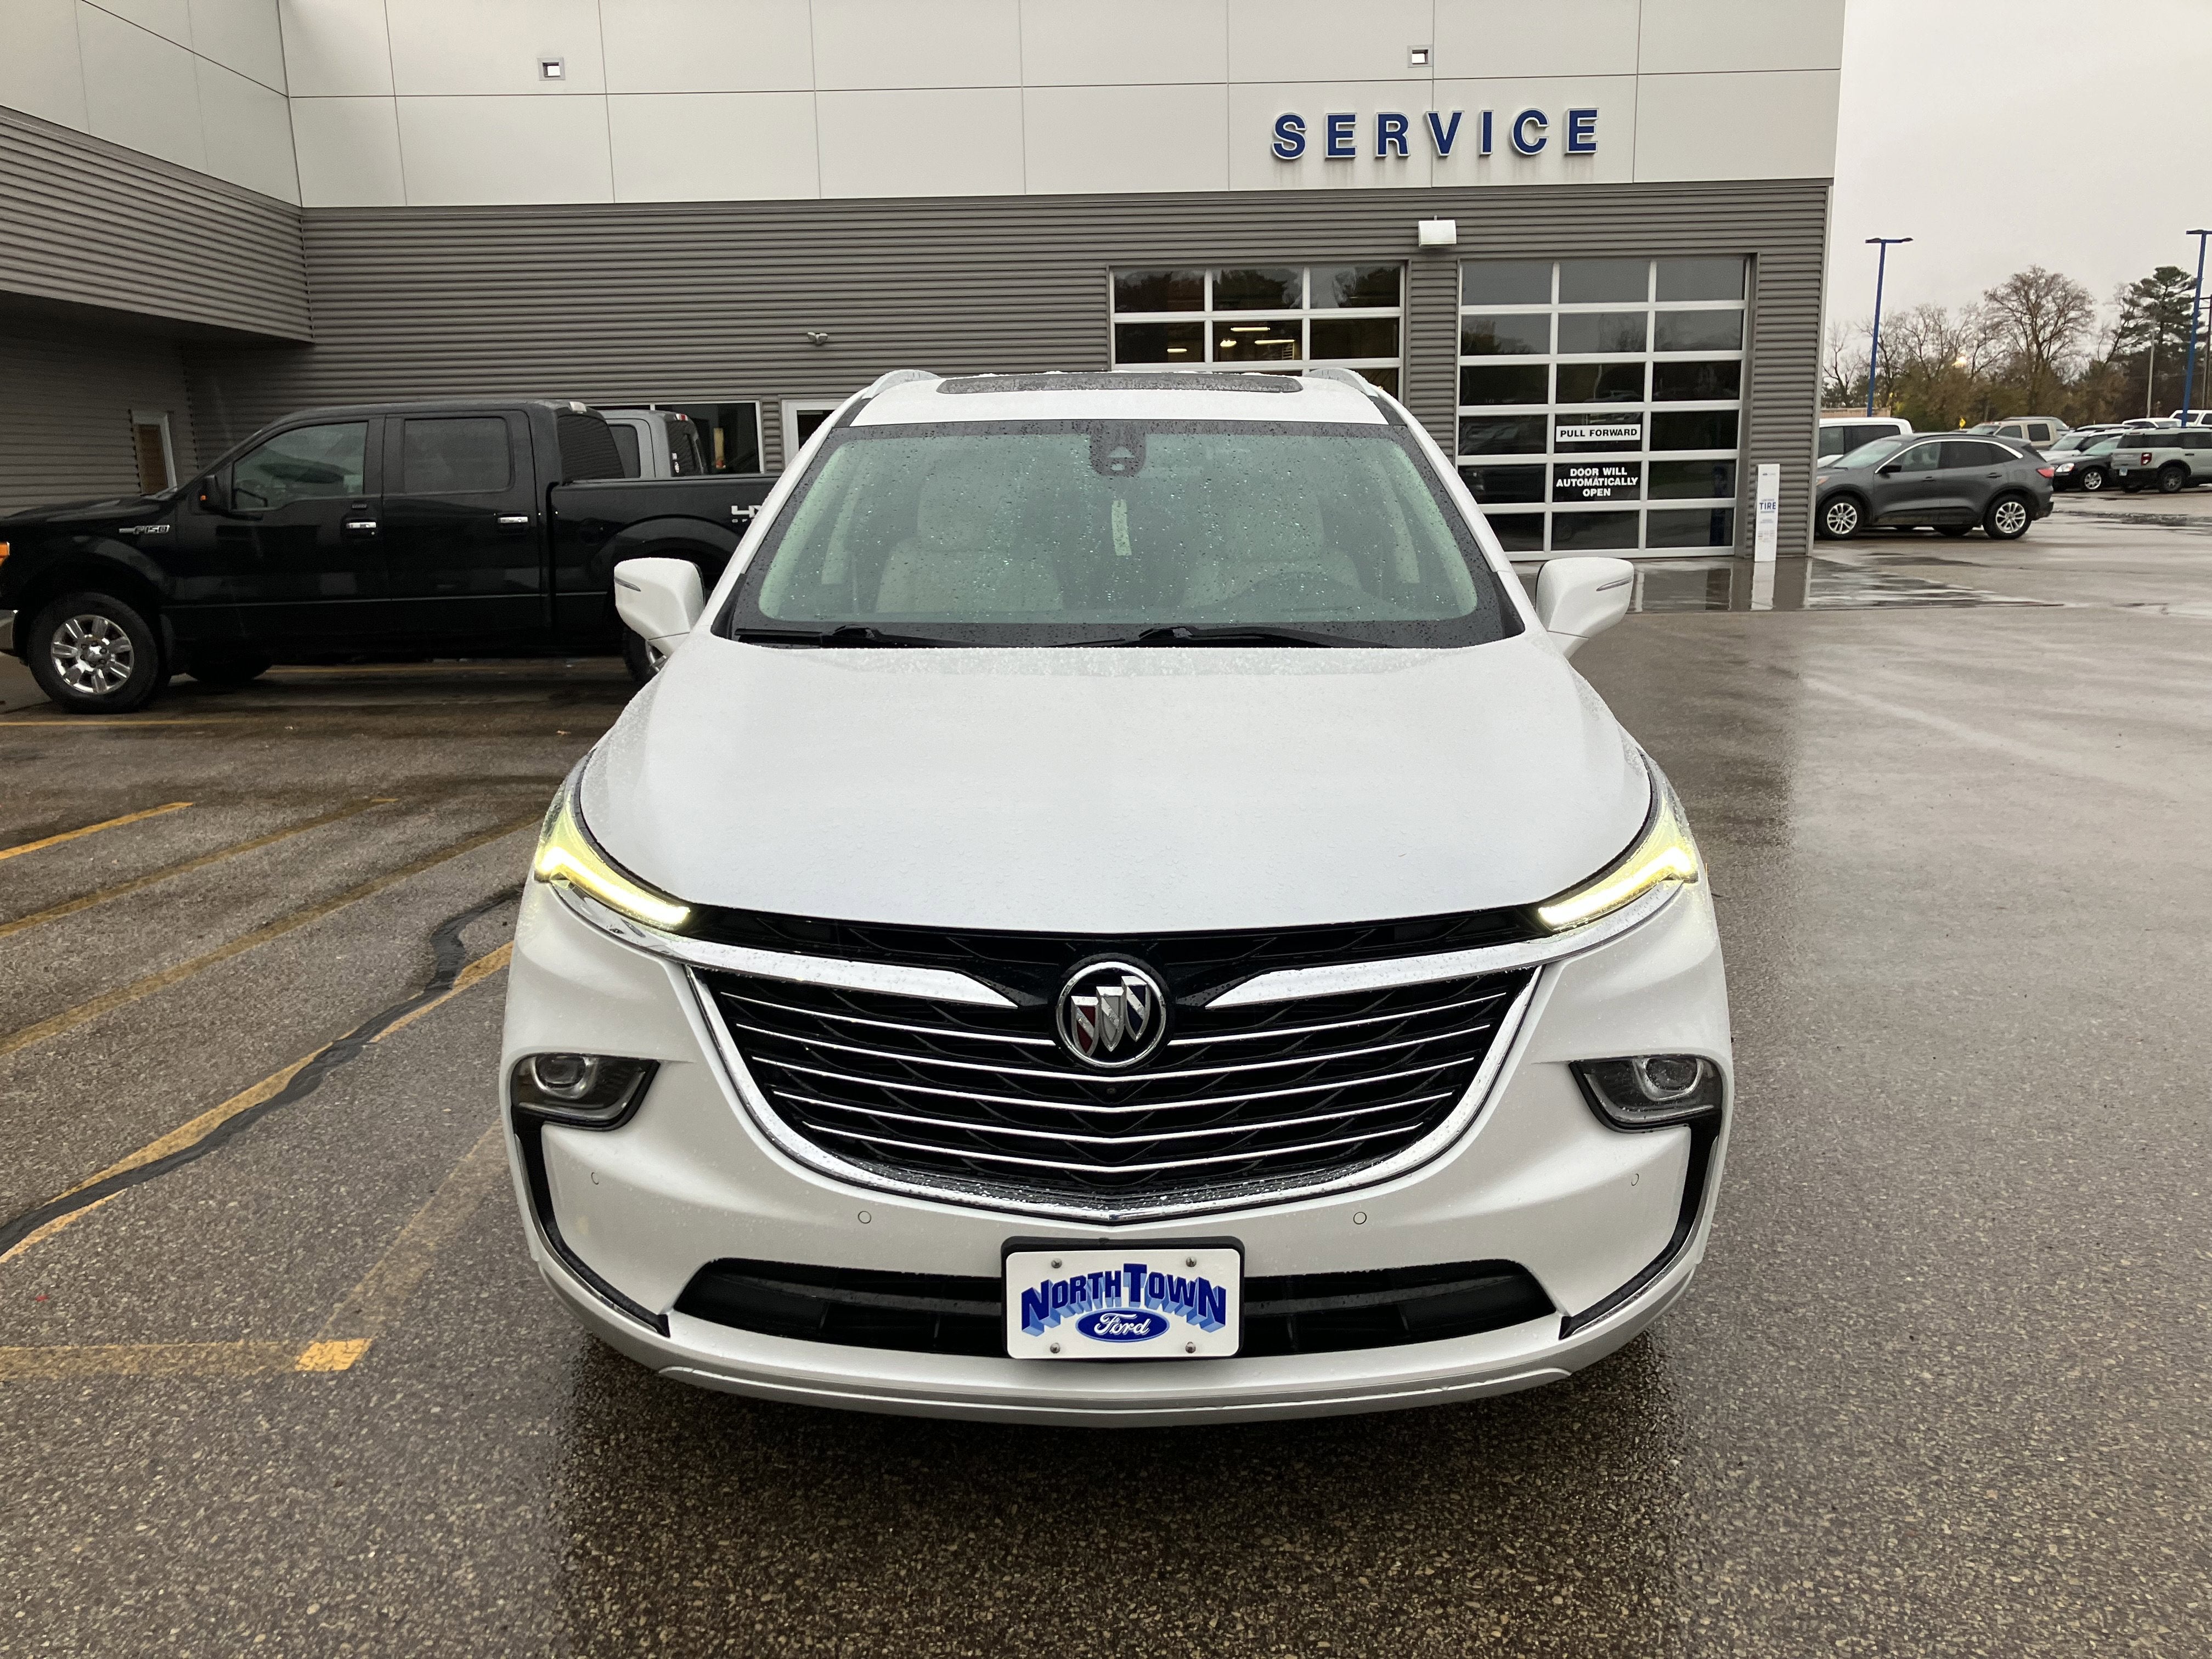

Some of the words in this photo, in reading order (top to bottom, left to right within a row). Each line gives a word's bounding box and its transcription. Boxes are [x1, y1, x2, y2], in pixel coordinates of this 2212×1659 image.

[1272, 108, 1599, 160] SERVICE
[1589, 428, 1638, 437] FORWARD
[1570, 467, 1599, 476] DOOR
[1602, 467, 1627, 476] WILL
[1556, 477, 1639, 487] AUTOMATICALLY
[1582, 488, 1611, 496] OPEN
[1759, 501, 1776, 510] TIRE
[1094, 1313, 1151, 1335] Ford
